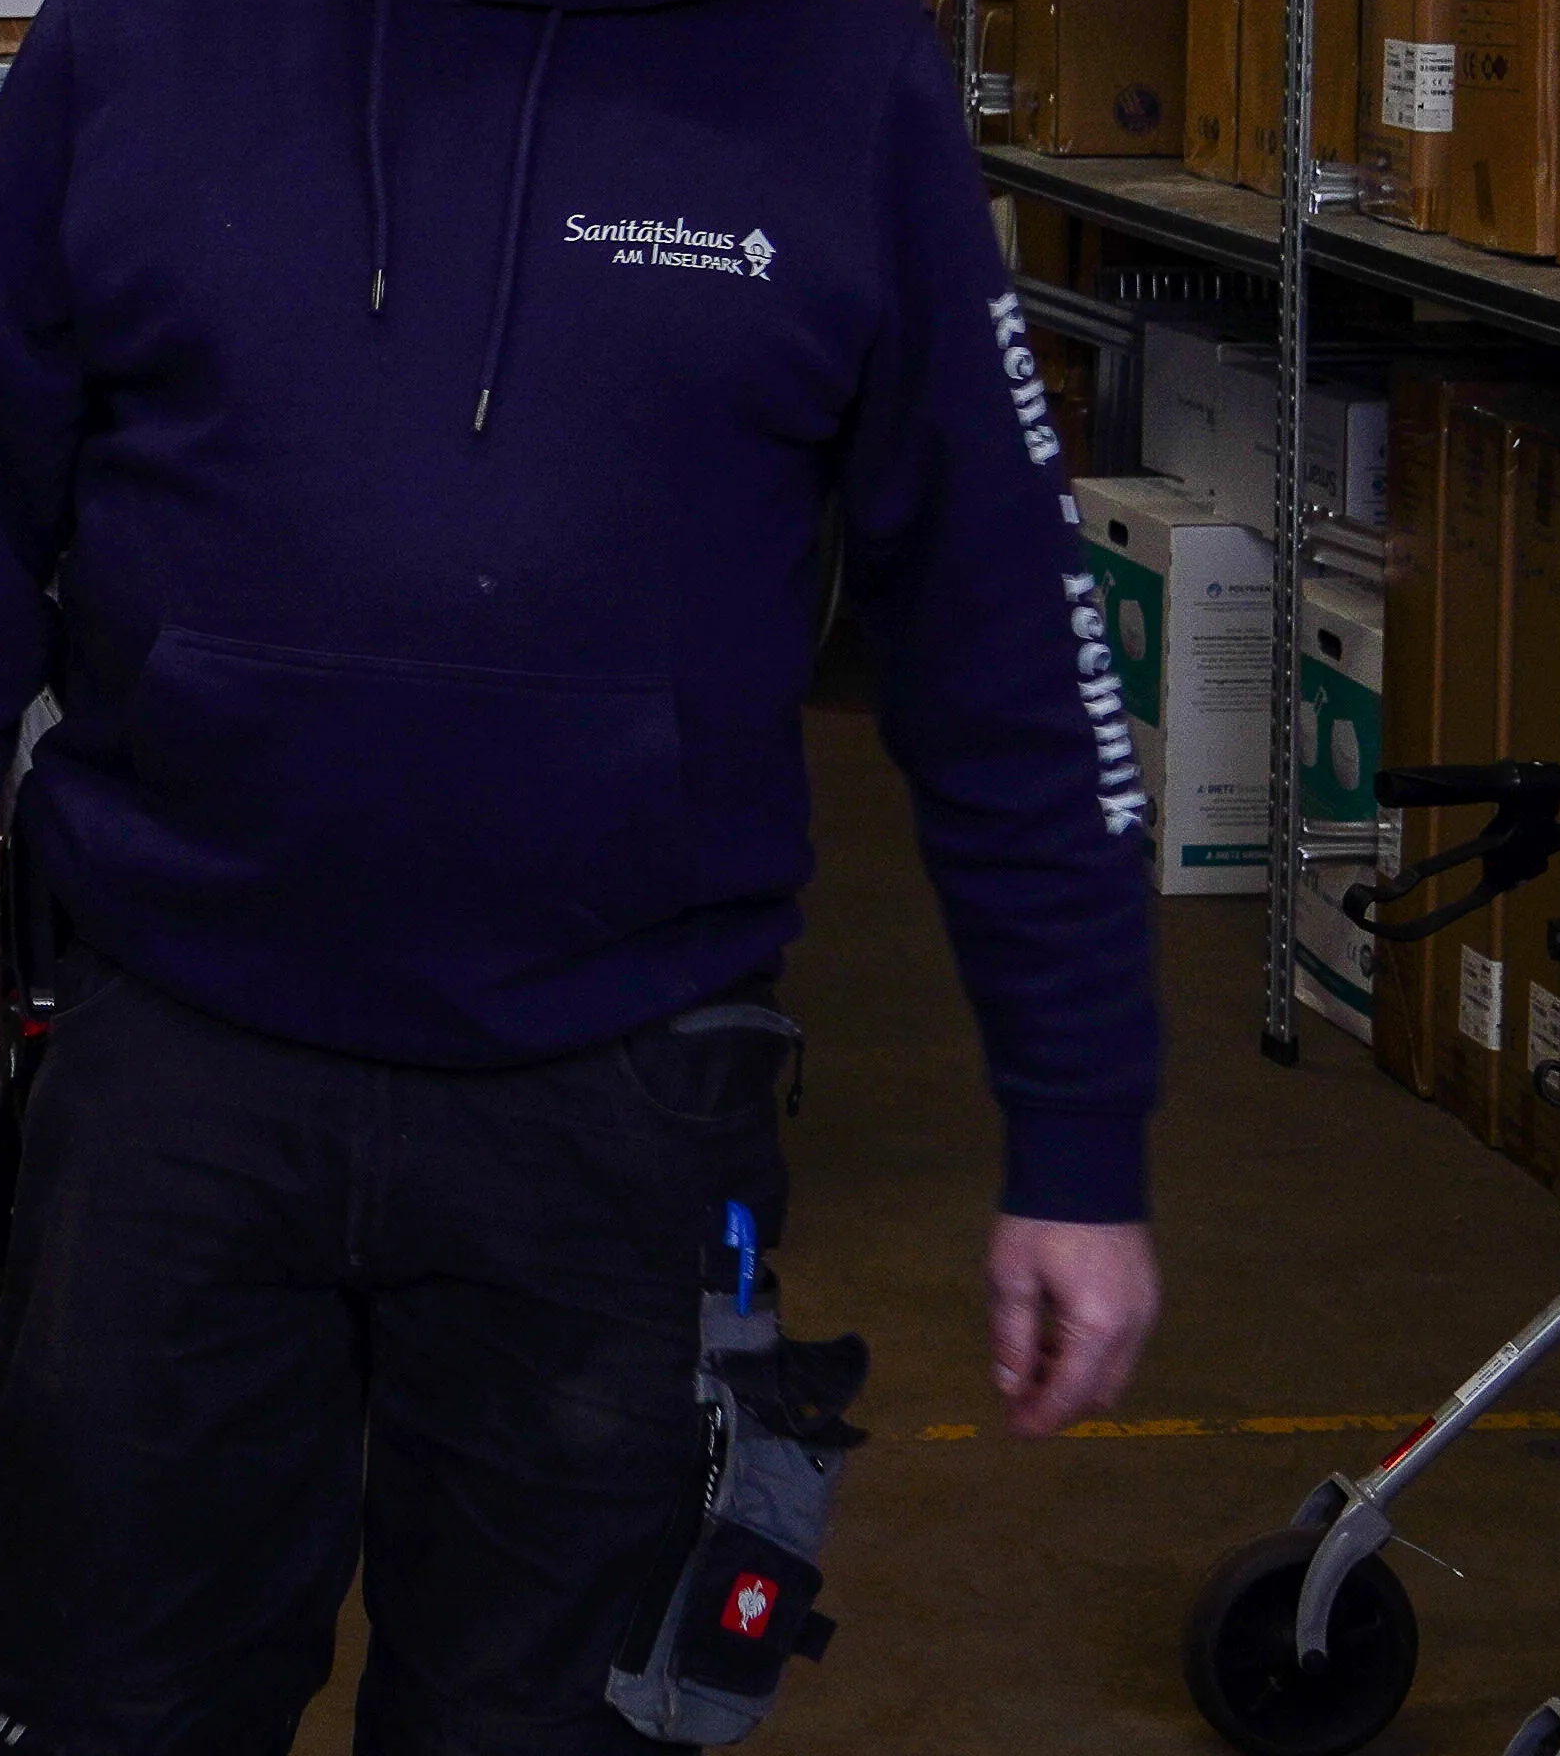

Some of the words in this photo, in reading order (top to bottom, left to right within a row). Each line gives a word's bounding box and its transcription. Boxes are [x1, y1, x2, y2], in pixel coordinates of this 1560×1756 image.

[564, 214, 734, 249] Sanitätshaus
[612, 248, 644, 265] AM
[650, 243, 743, 276] INSELPARK
